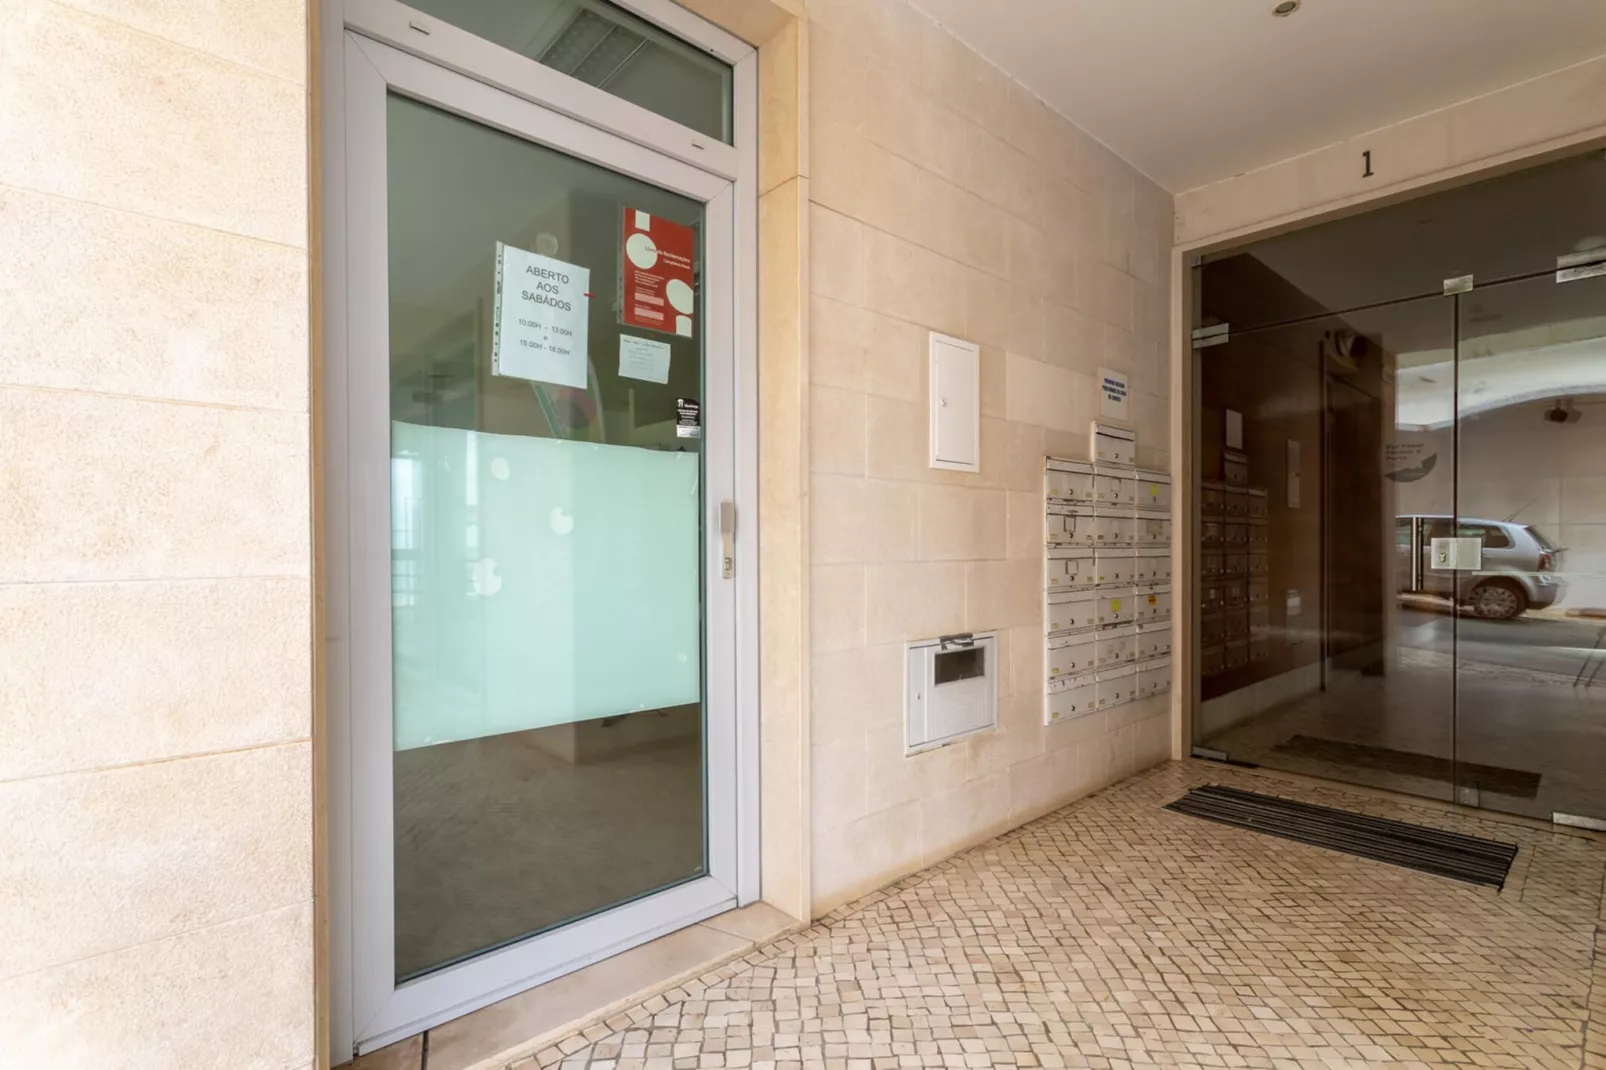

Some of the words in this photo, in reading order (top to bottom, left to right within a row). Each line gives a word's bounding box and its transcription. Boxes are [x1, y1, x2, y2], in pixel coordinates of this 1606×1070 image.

[1362, 150, 1374, 178] 1
[526, 265, 569, 284] ABERTO
[536, 281, 559, 295] AOS
[521, 290, 571, 311] SABÁDOS
